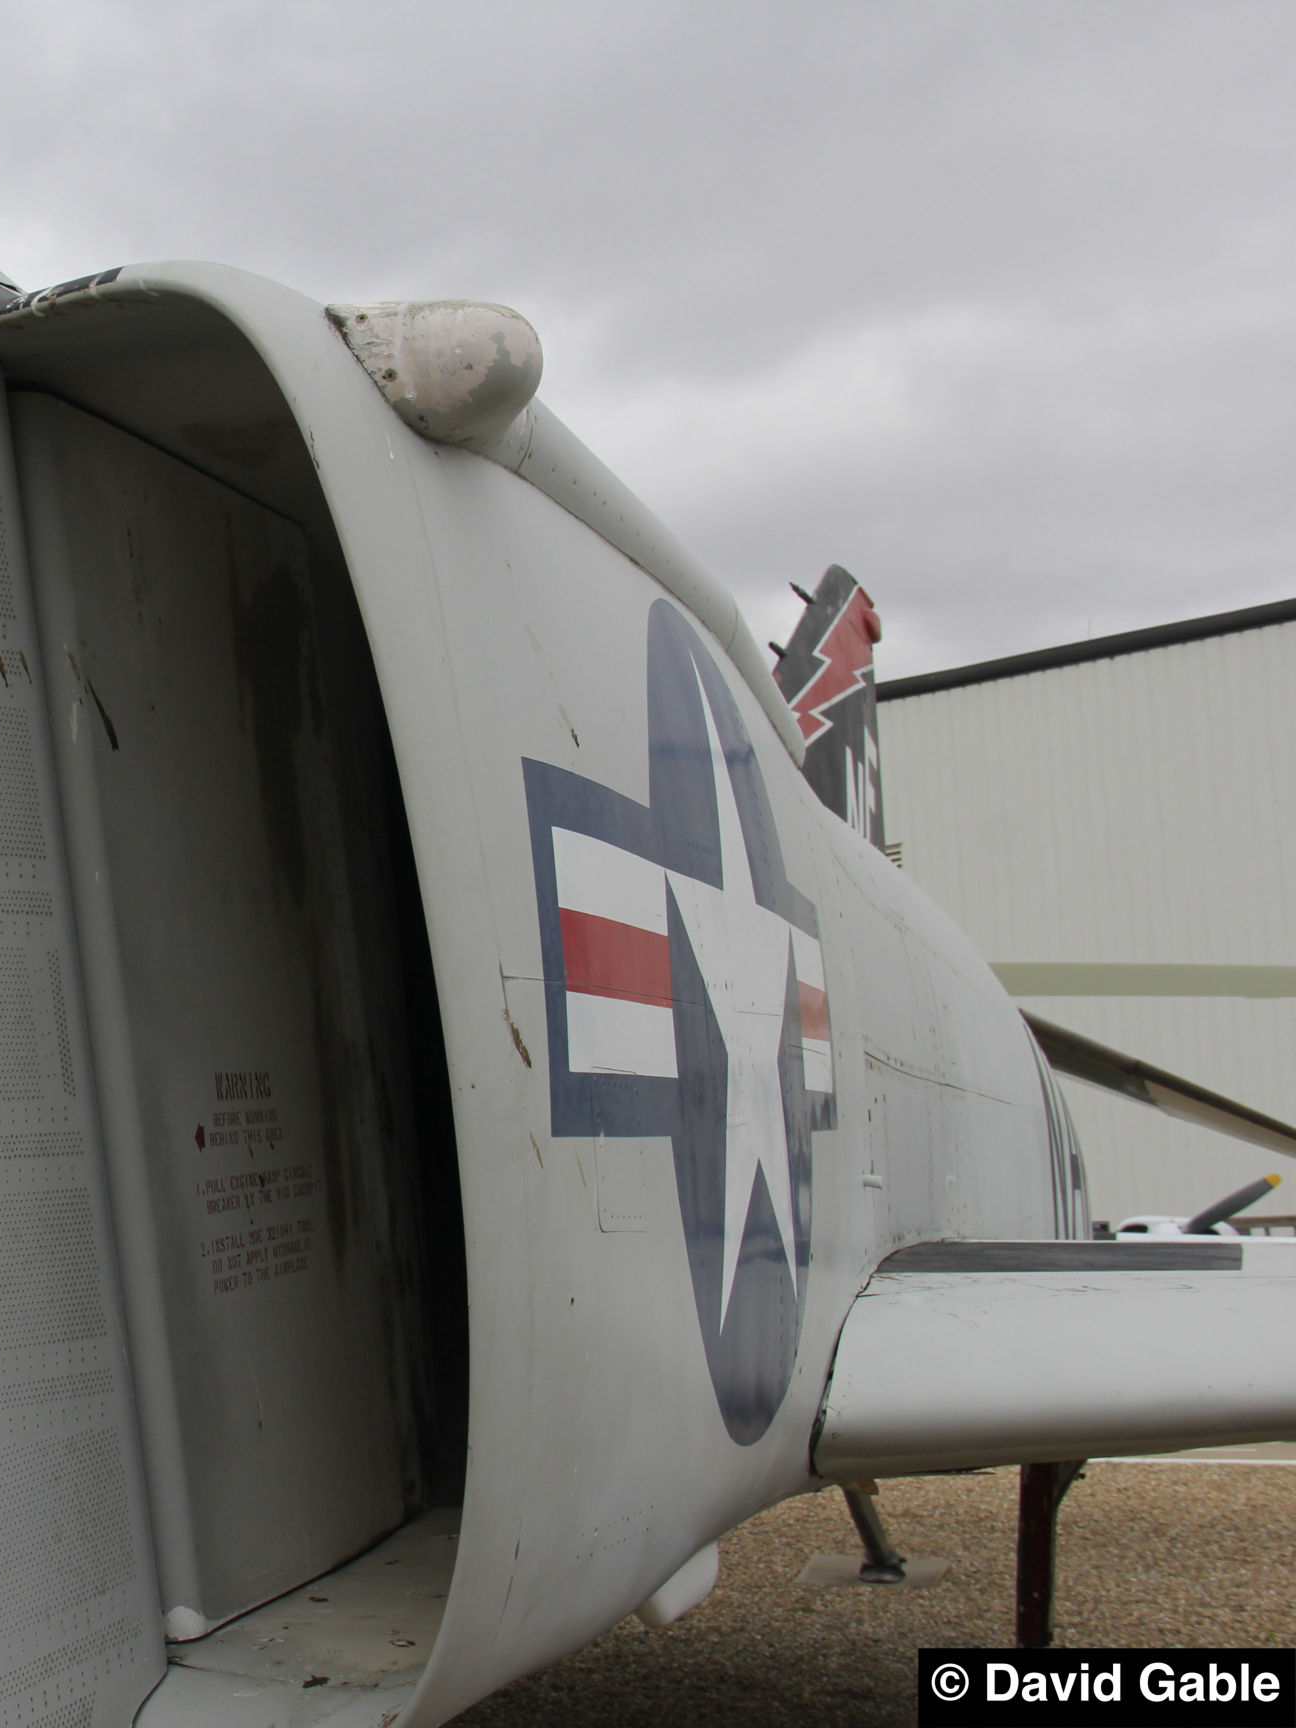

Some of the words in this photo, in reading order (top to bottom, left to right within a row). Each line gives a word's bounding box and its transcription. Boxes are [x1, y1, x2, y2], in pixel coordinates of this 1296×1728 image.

[214, 1071, 272, 1101] WARNING
[243, 1128, 262, 1144] THIS
[206, 1195, 241, 1214] BREAKER
[258, 1188, 272, 1205] THE
[212, 1259, 223, 1275] DO
[227, 1253, 242, 1270] NOT
[246, 1246, 269, 1267] APPLY
[242, 1271, 253, 1288] TO
[256, 1265, 270, 1283] THE
